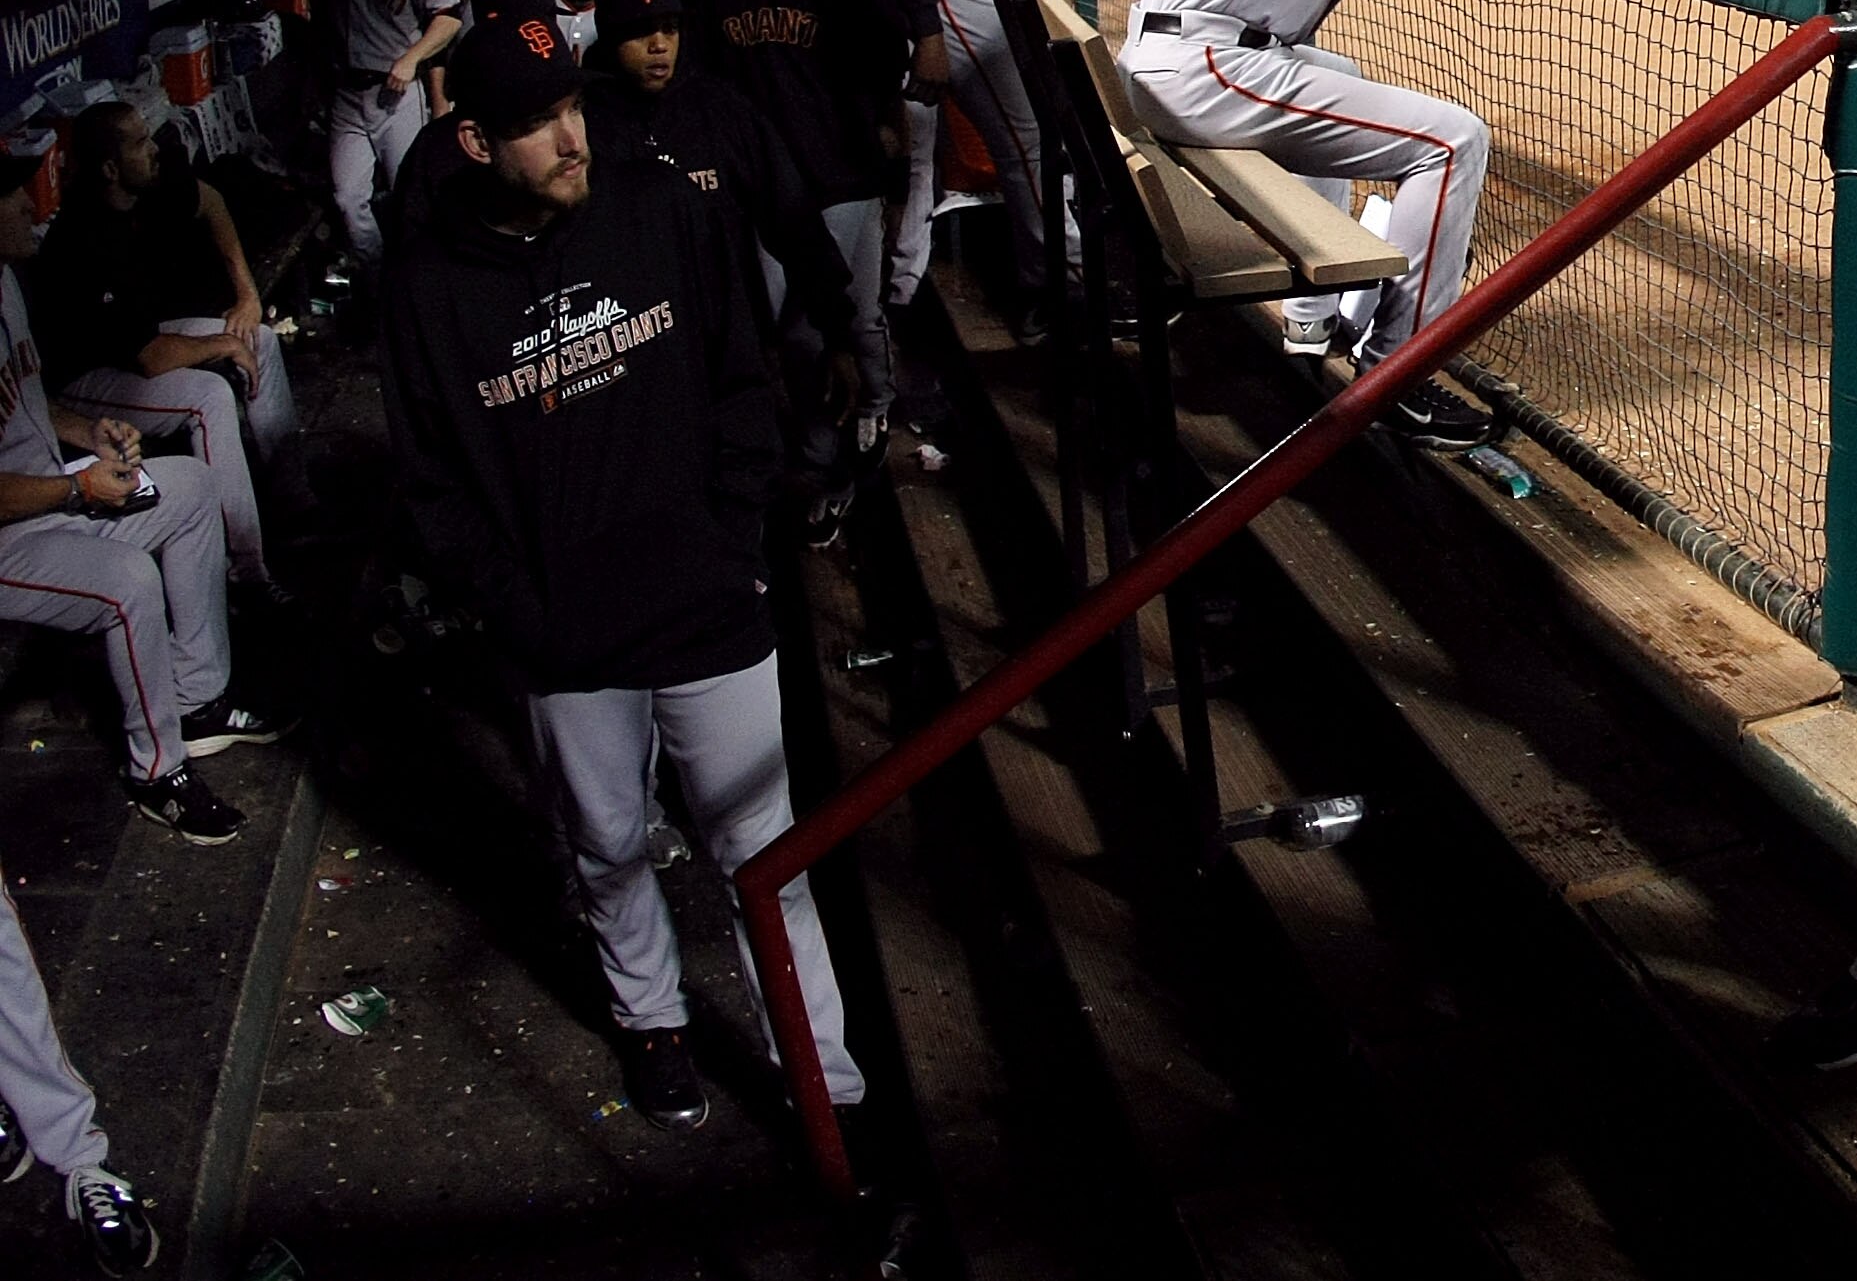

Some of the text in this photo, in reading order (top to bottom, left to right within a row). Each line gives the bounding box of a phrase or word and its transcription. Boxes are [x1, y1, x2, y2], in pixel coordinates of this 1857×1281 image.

[518, 20, 555, 59] SF
[478, 300, 674, 407] SAN FRANCISCO GIANTS
[512, 328, 551, 357] 2010
[562, 372, 611, 400] ASEBALL
